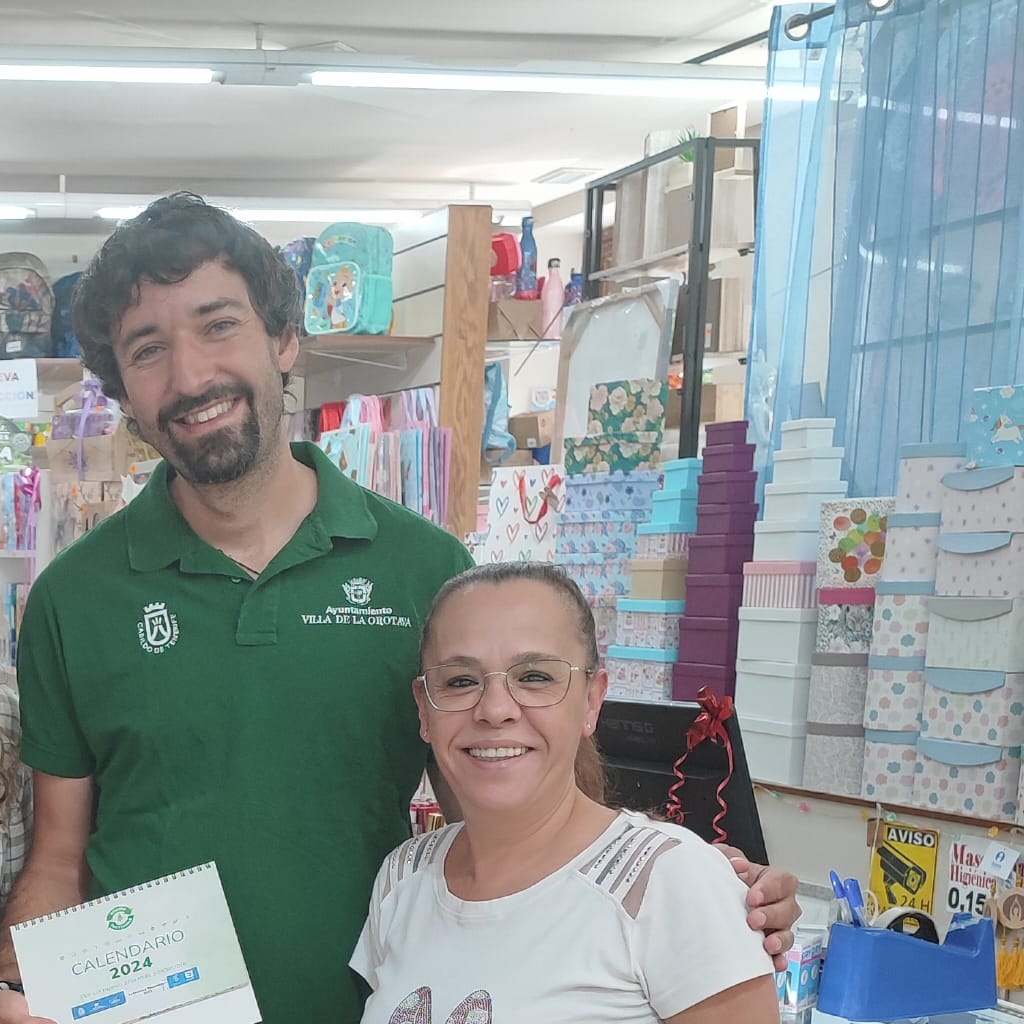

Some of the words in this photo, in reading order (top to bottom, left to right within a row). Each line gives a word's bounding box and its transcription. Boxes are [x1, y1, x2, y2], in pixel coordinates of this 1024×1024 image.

[325, 606, 393, 616] Ayuntamiento
[301, 614, 332, 625] VILLA
[336, 615, 351, 625] DE
[352, 615, 366, 625] LA
[367, 616, 412, 627] OROTAVA
[888, 828, 935, 847] AVISO
[900, 895, 916, 907] 24
[920, 899, 930, 912] H
[71, 930, 184, 975] CALENDARIO
[109, 956, 153, 979] 2024
